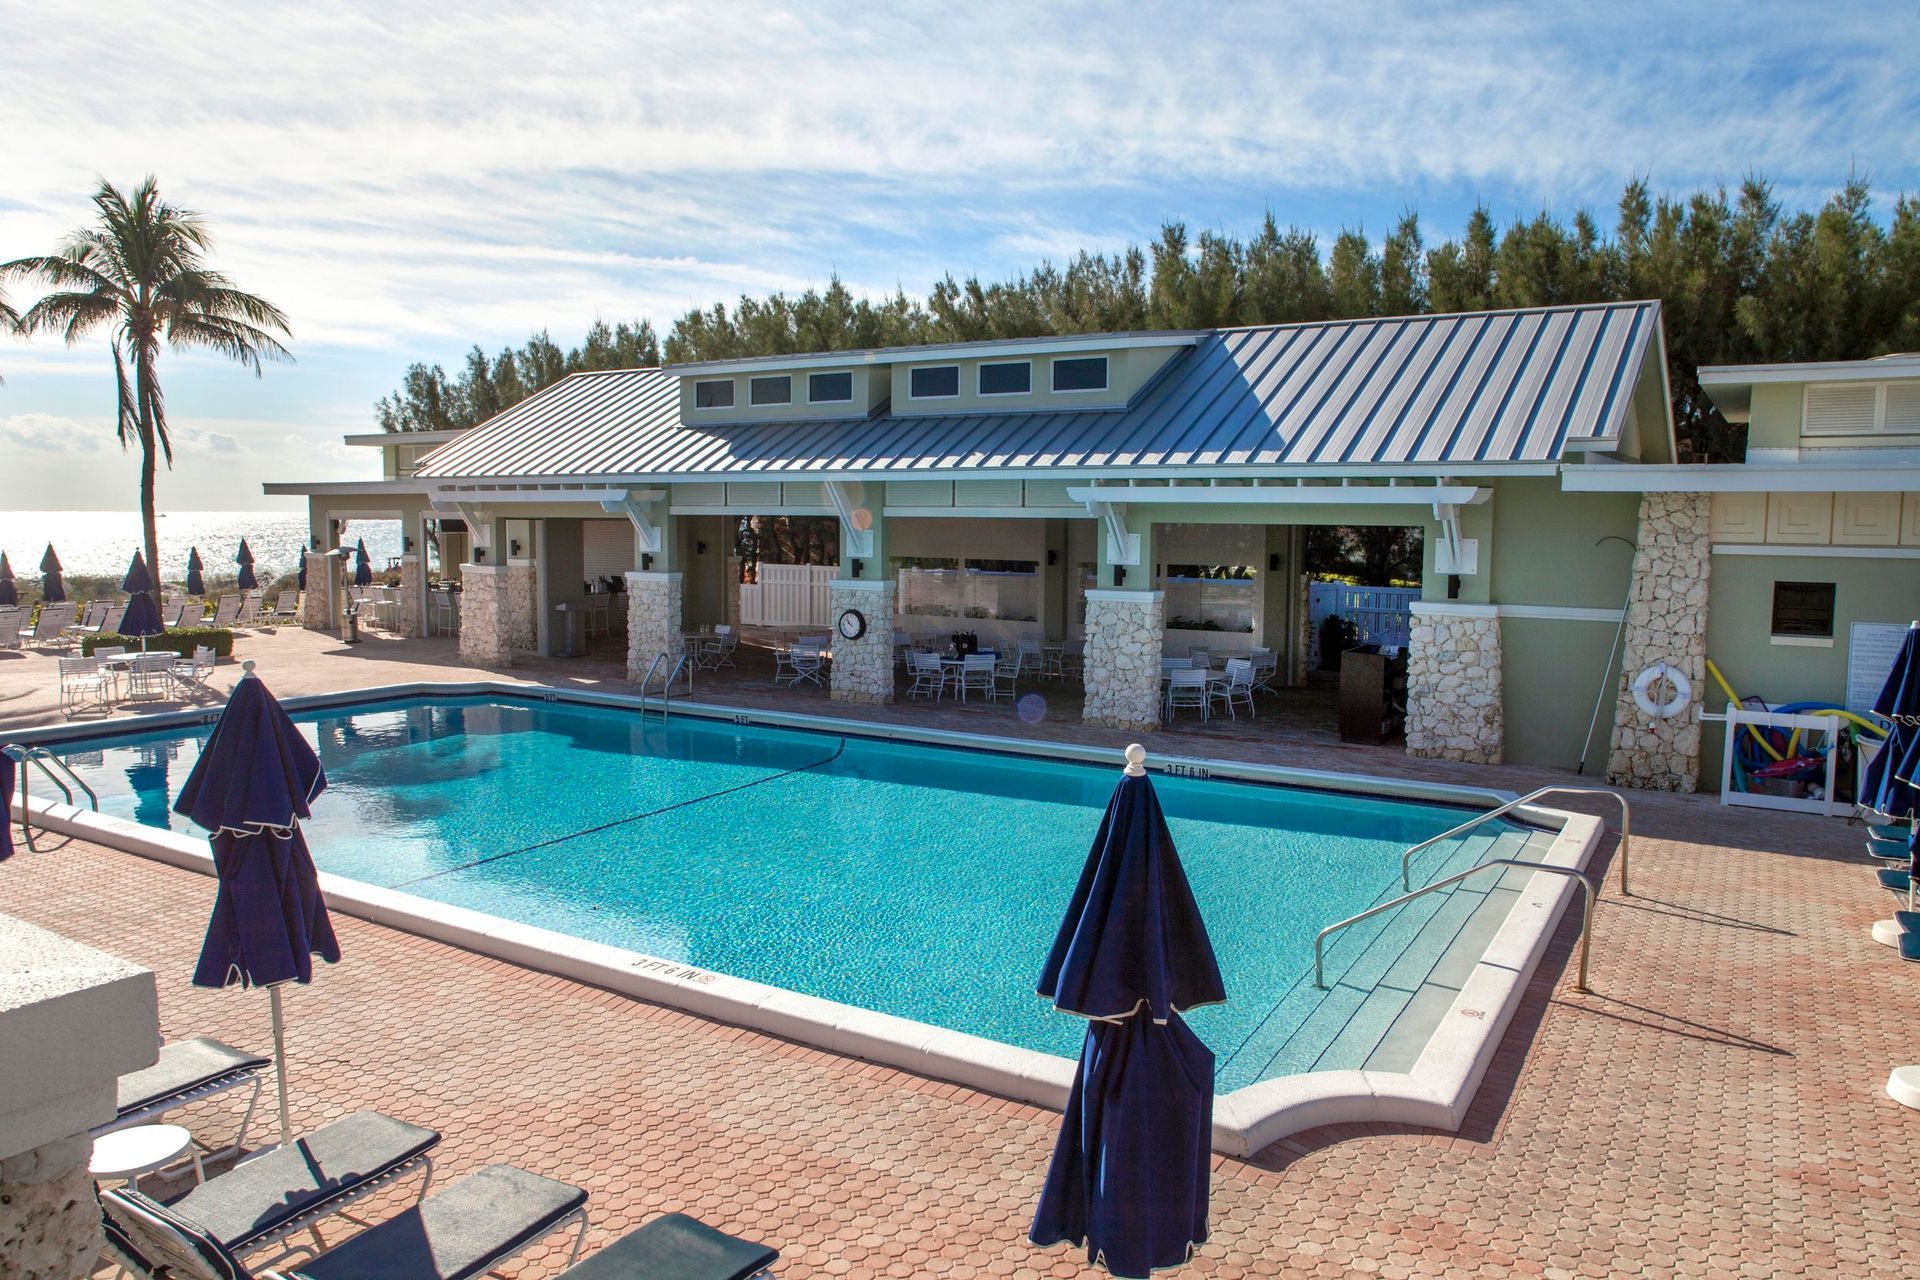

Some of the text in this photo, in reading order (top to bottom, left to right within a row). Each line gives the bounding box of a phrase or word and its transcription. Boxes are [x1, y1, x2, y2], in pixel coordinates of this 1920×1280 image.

[1167, 763, 1209, 779] 3 FT 6 IN
[631, 958, 701, 980] 3 FT 6 IN
